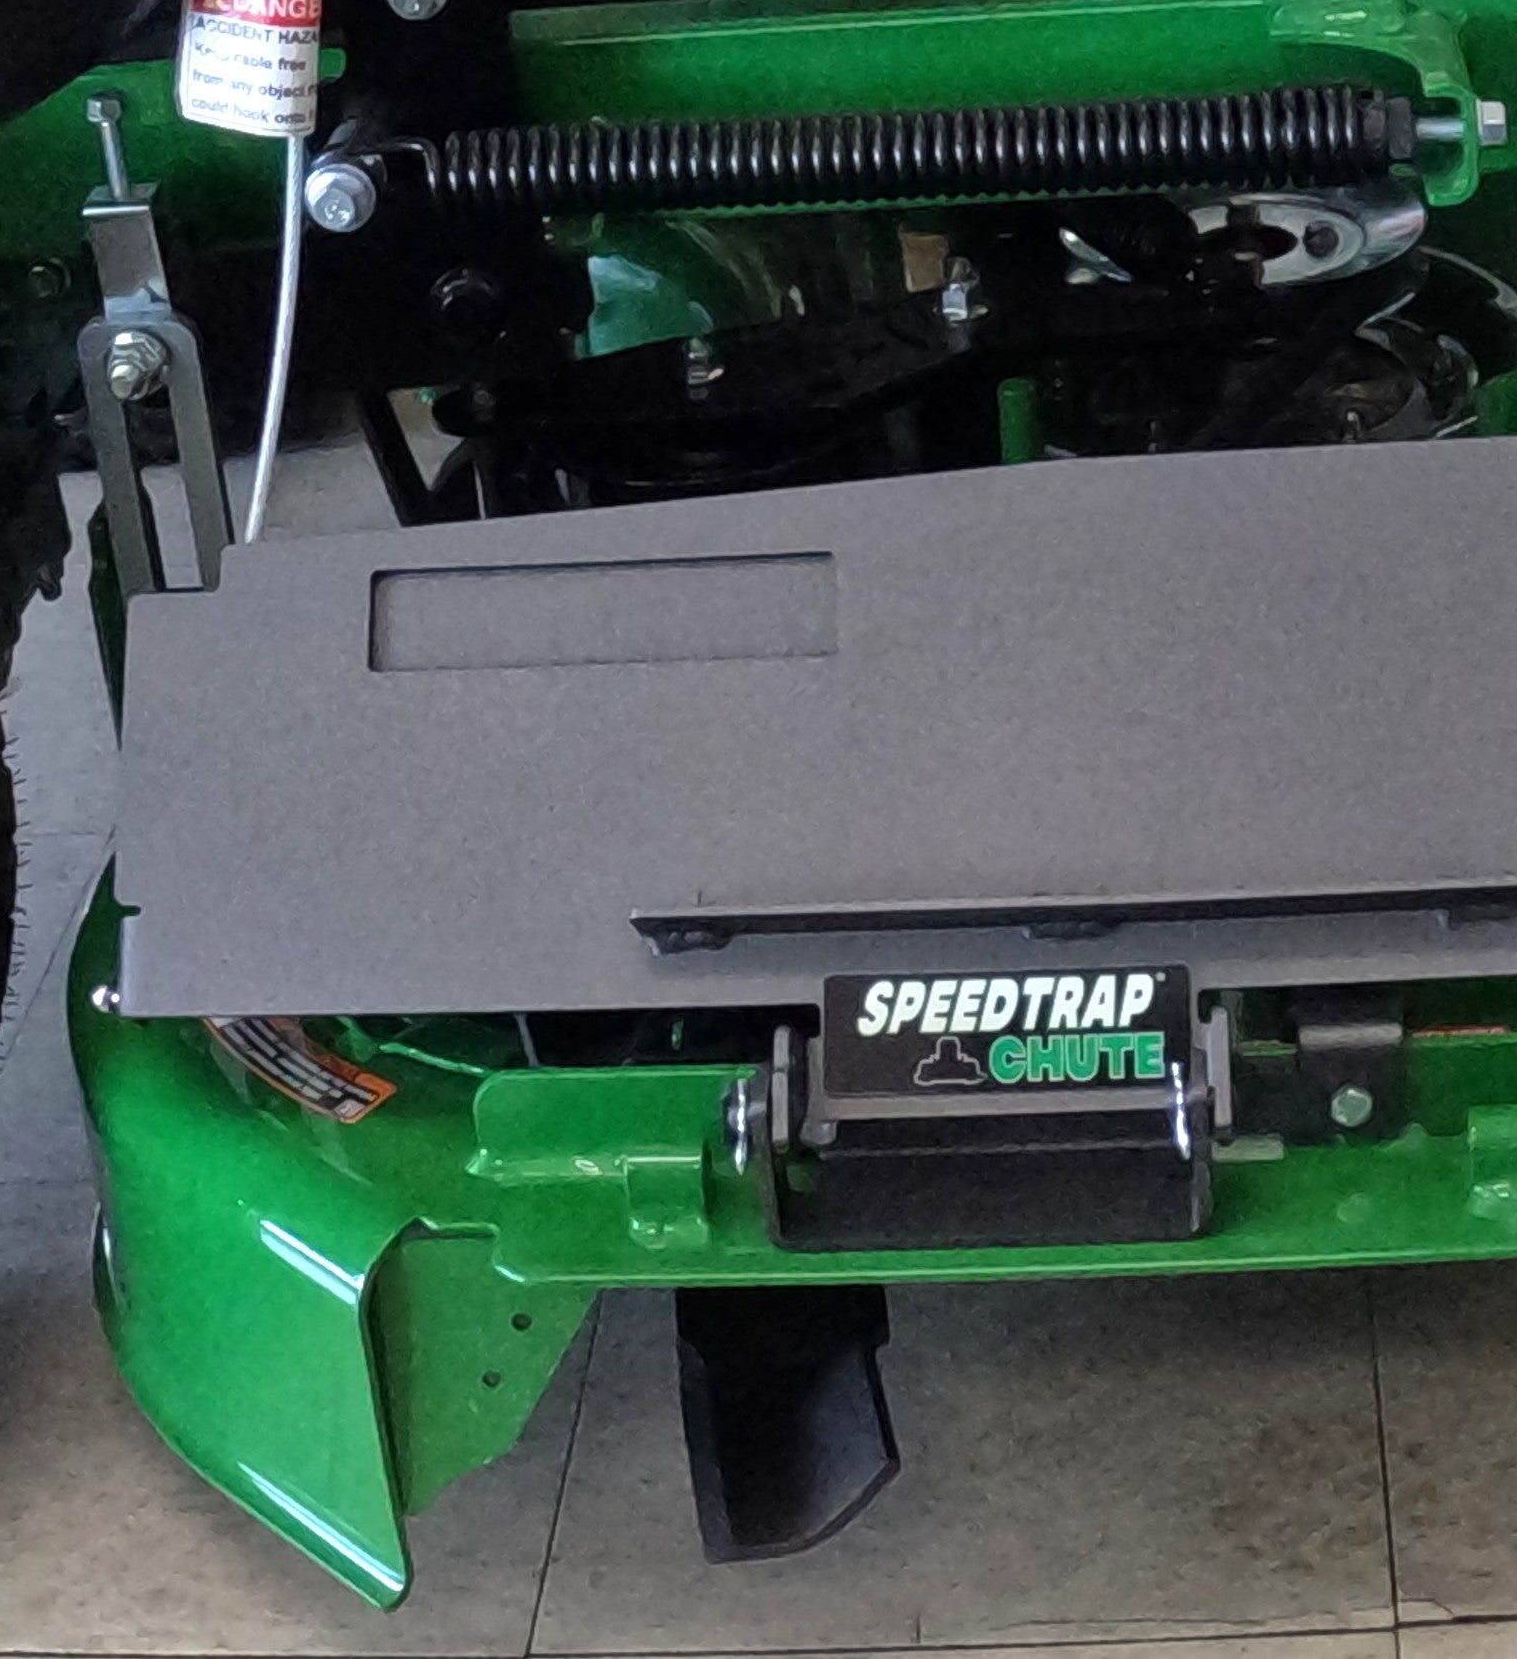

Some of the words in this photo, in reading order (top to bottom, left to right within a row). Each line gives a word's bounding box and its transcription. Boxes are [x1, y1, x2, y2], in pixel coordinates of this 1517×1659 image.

[278, 56, 307, 72] free
[857, 972, 1155, 1037] SPEEDTRAP
[989, 1032, 1166, 1084] CHUTE
